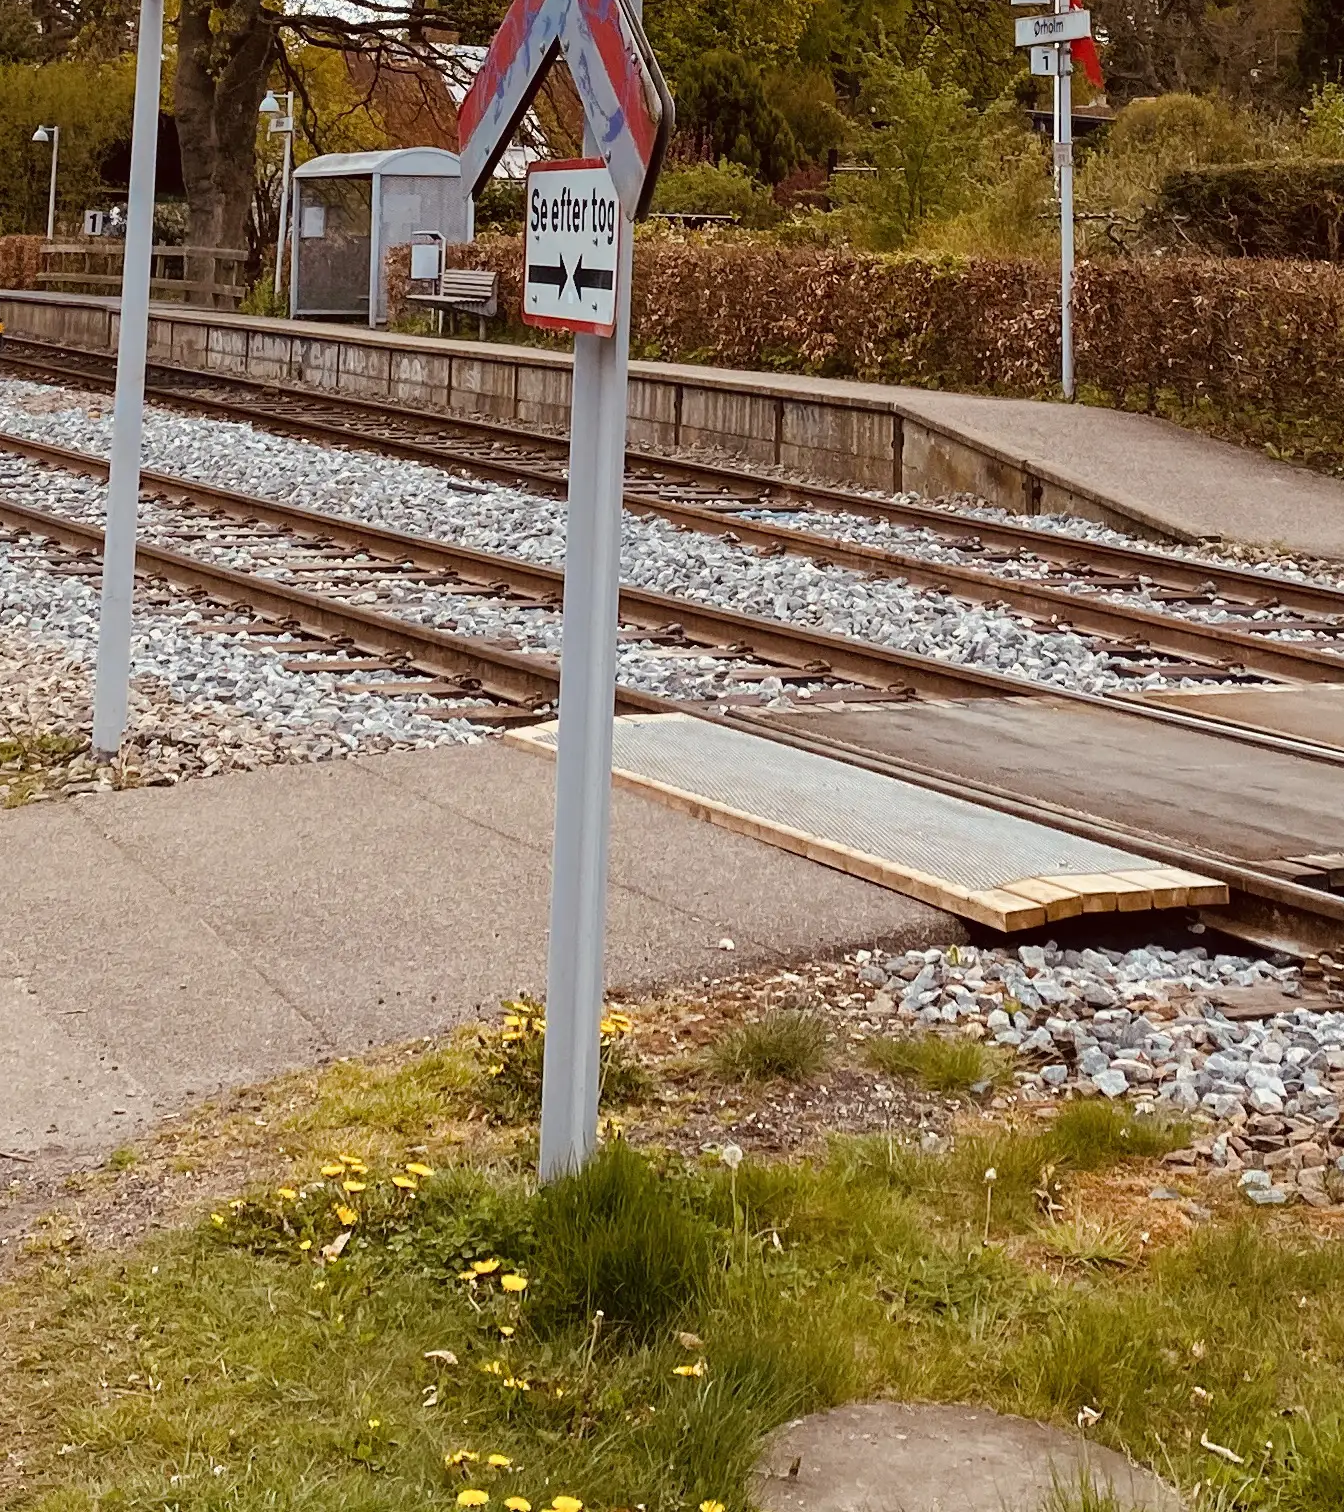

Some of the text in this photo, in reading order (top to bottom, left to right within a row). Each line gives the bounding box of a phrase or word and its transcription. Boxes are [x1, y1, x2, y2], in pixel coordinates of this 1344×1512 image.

[1034, 17, 1064, 37] Ørholm
[1042, 55, 1049, 70] 1
[89, 213, 97, 232] 1
[530, 187, 615, 245] Se efter tog
